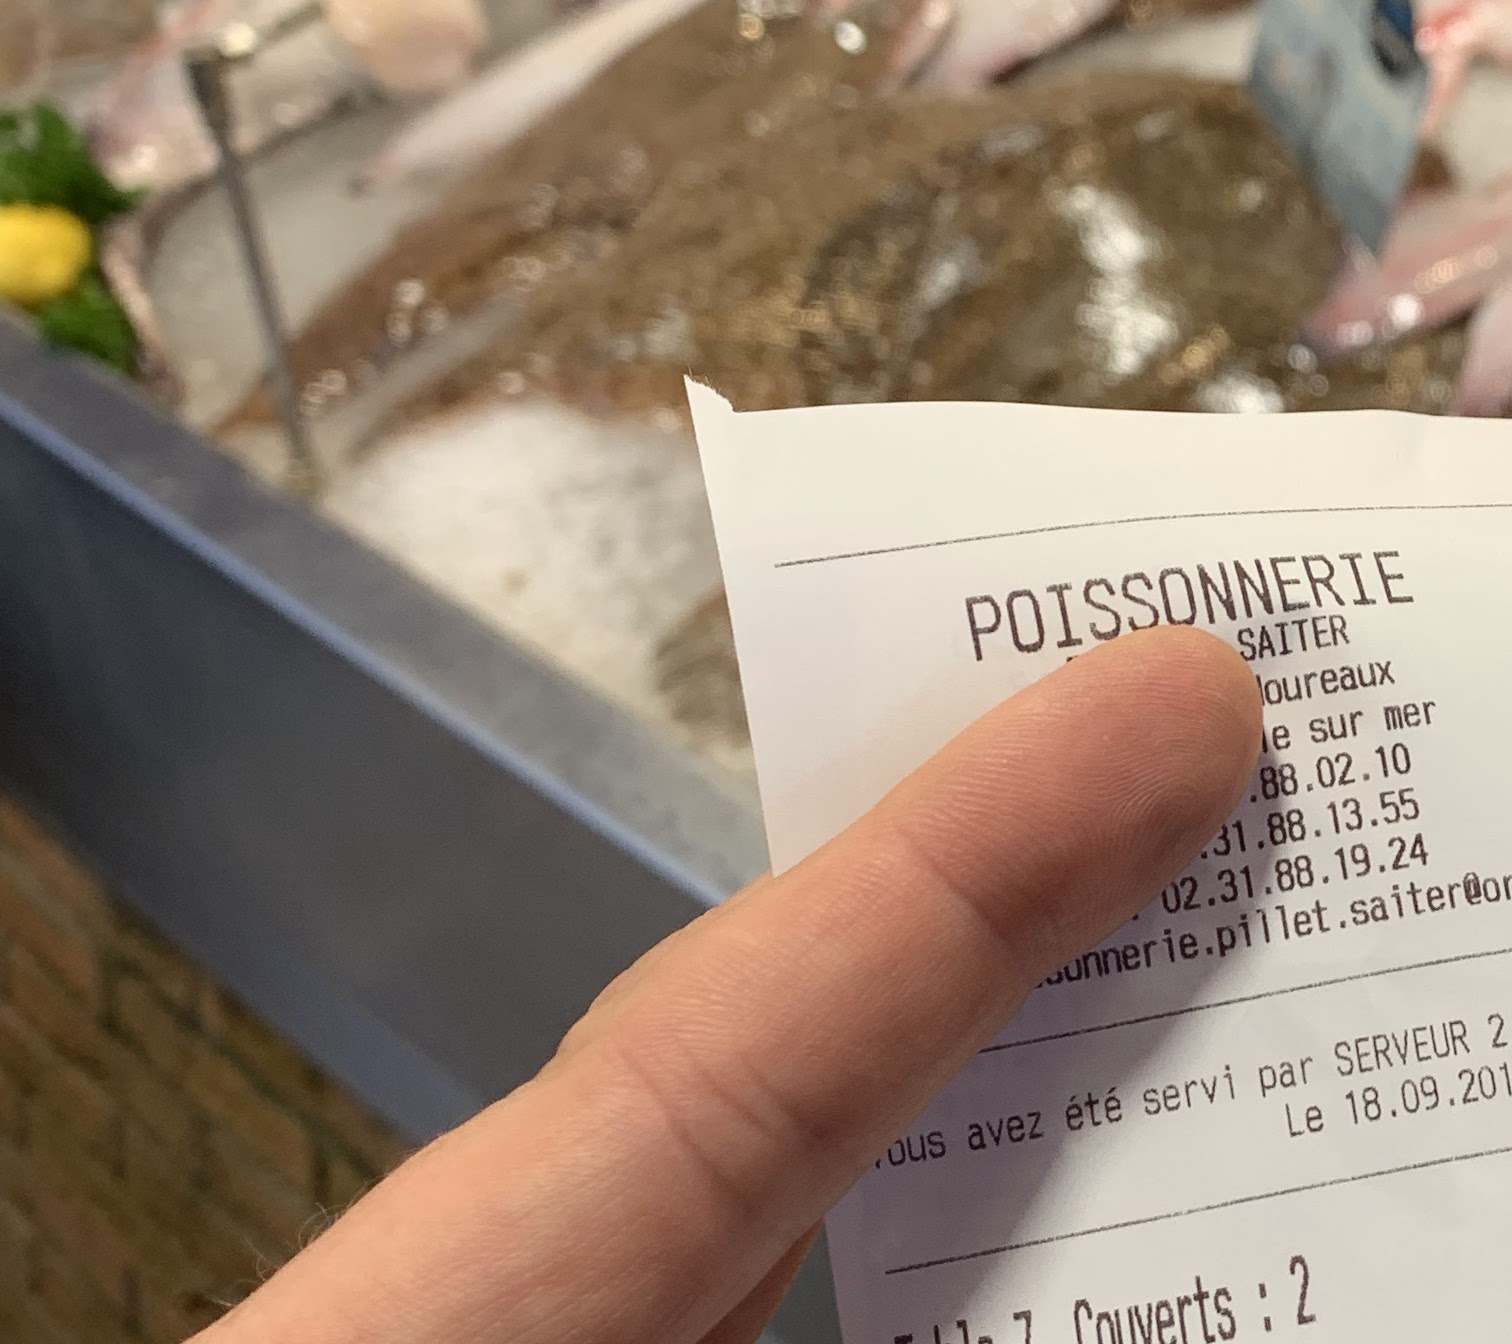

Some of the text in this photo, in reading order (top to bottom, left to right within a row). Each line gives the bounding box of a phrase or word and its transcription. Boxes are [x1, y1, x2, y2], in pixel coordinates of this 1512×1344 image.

[964, 550, 1415, 663] POISSONNERIE
[1237, 614, 1351, 662] SAITER
[1308, 710, 1364, 744] sur
[1382, 700, 1437, 732] mer
[1250, 742, 1412, 803] .88.02.10
[1200, 786, 1421, 859] .31.88.13.55
[1161, 832, 1430, 915] 02.31.88.19.24
[875, 1012, 1509, 1170] ous avez été servi par SERVEUR 2
[1284, 1102, 1325, 1138] Le
[1288, 1254, 1317, 1326] 2
